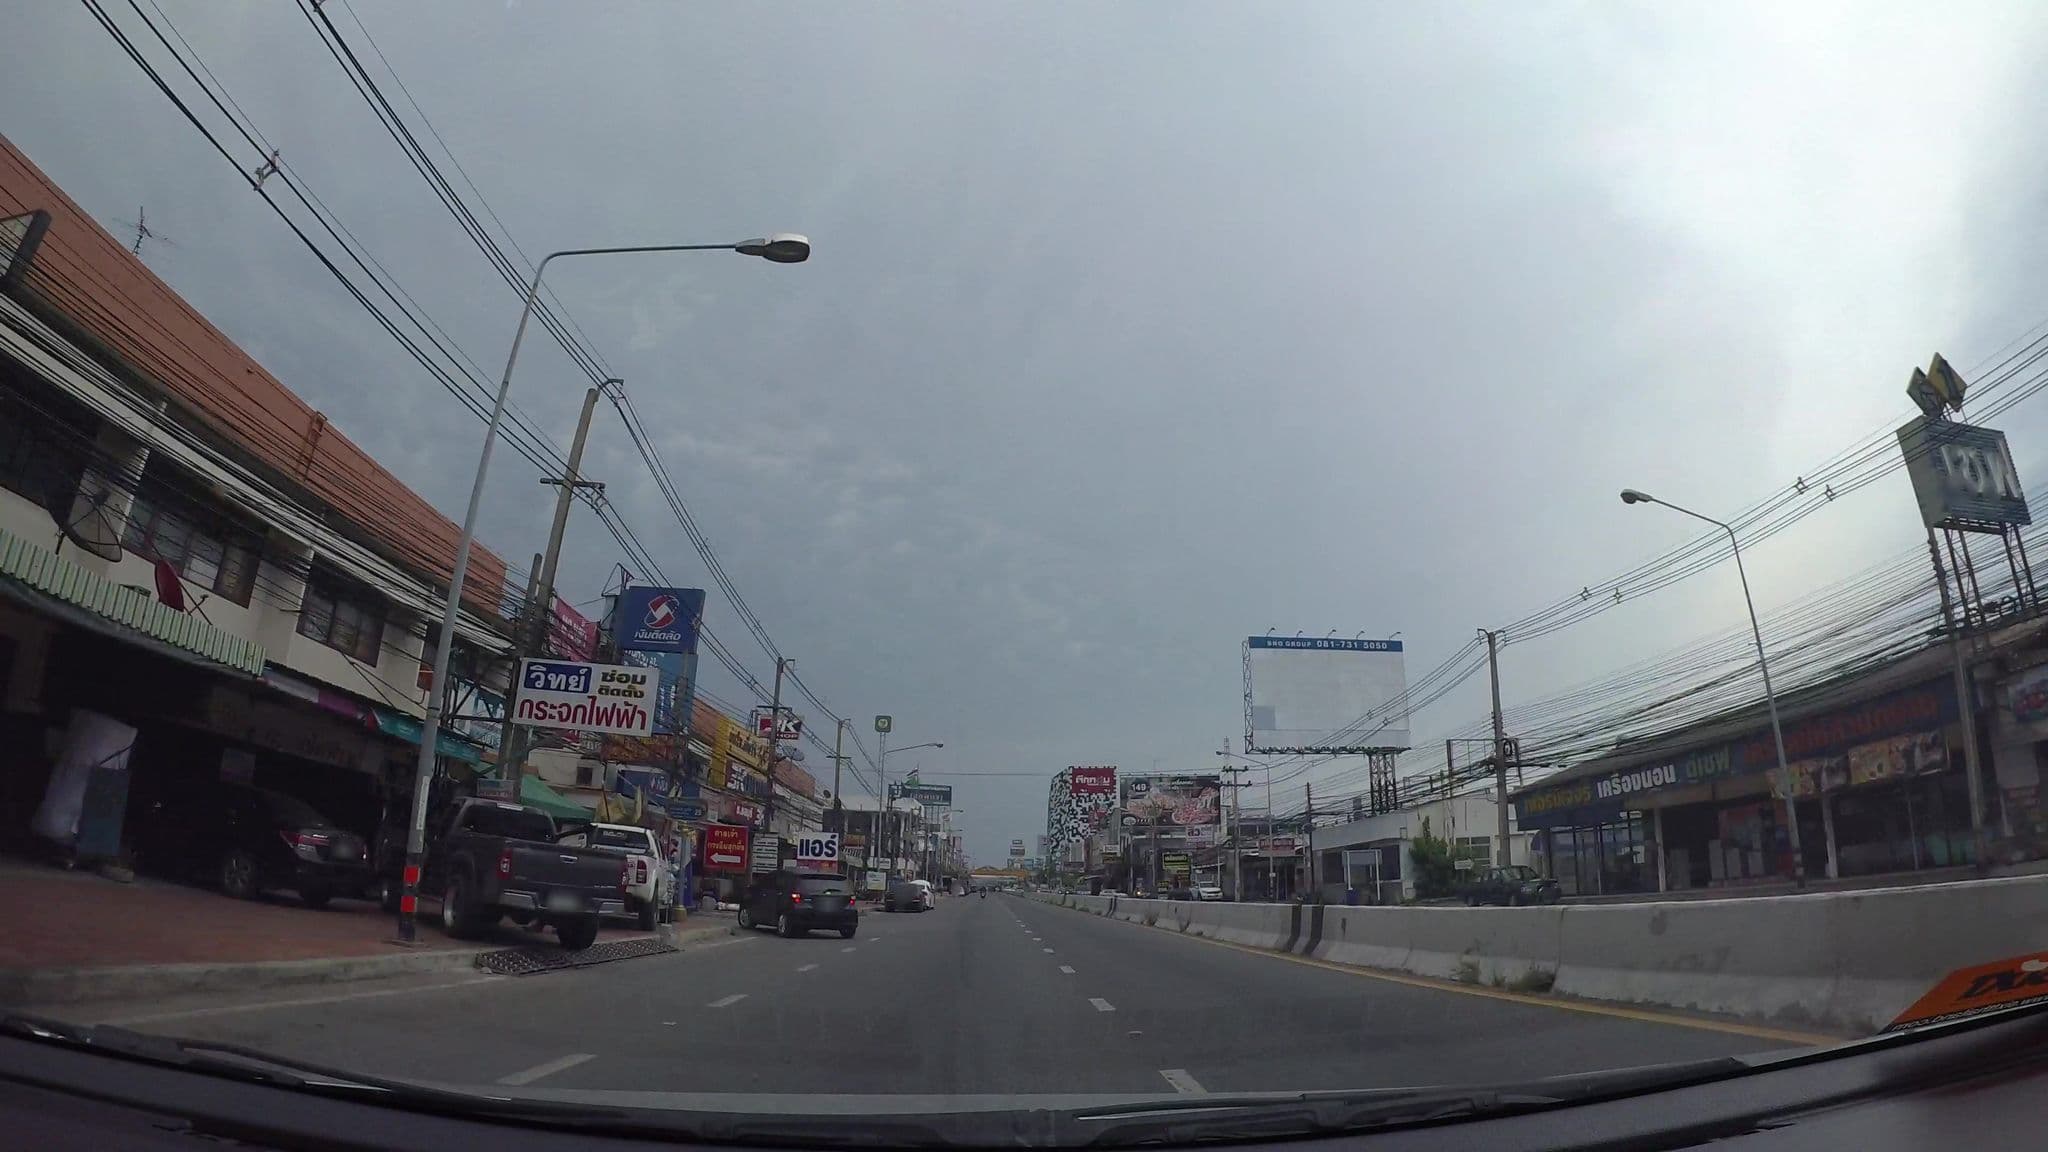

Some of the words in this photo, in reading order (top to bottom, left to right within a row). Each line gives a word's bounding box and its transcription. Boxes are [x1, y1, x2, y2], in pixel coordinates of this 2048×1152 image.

[634, 628, 682, 641] เงินติดล้อ
[1285, 640, 1312, 648] GROUP
[1316, 640, 1358, 649] 081-731
[1363, 641, 1388, 650] 5050
[529, 664, 589, 692] วิทย์
[601, 669, 647, 686] ซ่อม
[518, 695, 648, 731] กระจกไฟฟ้า
[1131, 783, 1147, 791] 149
[799, 834, 837, 858] แอร์
